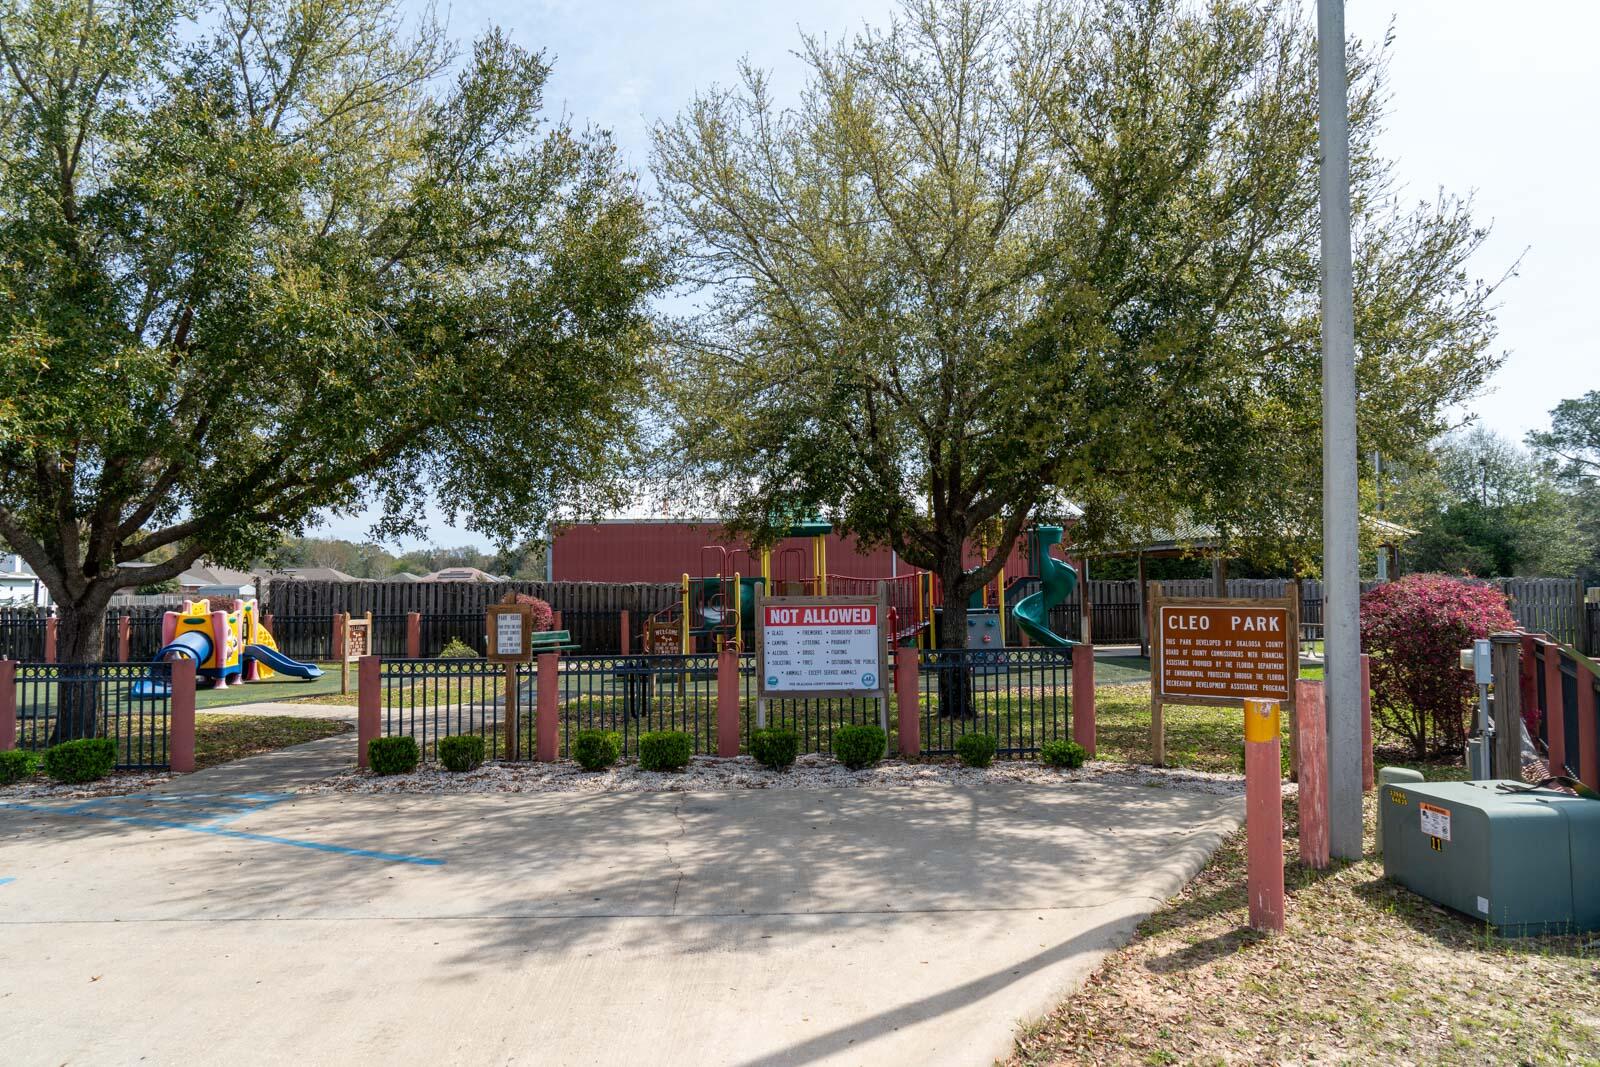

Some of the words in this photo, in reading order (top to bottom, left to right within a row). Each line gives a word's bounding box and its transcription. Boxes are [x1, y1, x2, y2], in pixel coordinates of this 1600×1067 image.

[770, 608, 799, 624] NOT
[803, 608, 871, 624] ALLOWED
[1168, 615, 1210, 630] CLEO
[1231, 616, 1280, 632] PARK
[1196, 681, 1226, 689] DEVELOPMENT
[1432, 836, 1441, 851] 11
